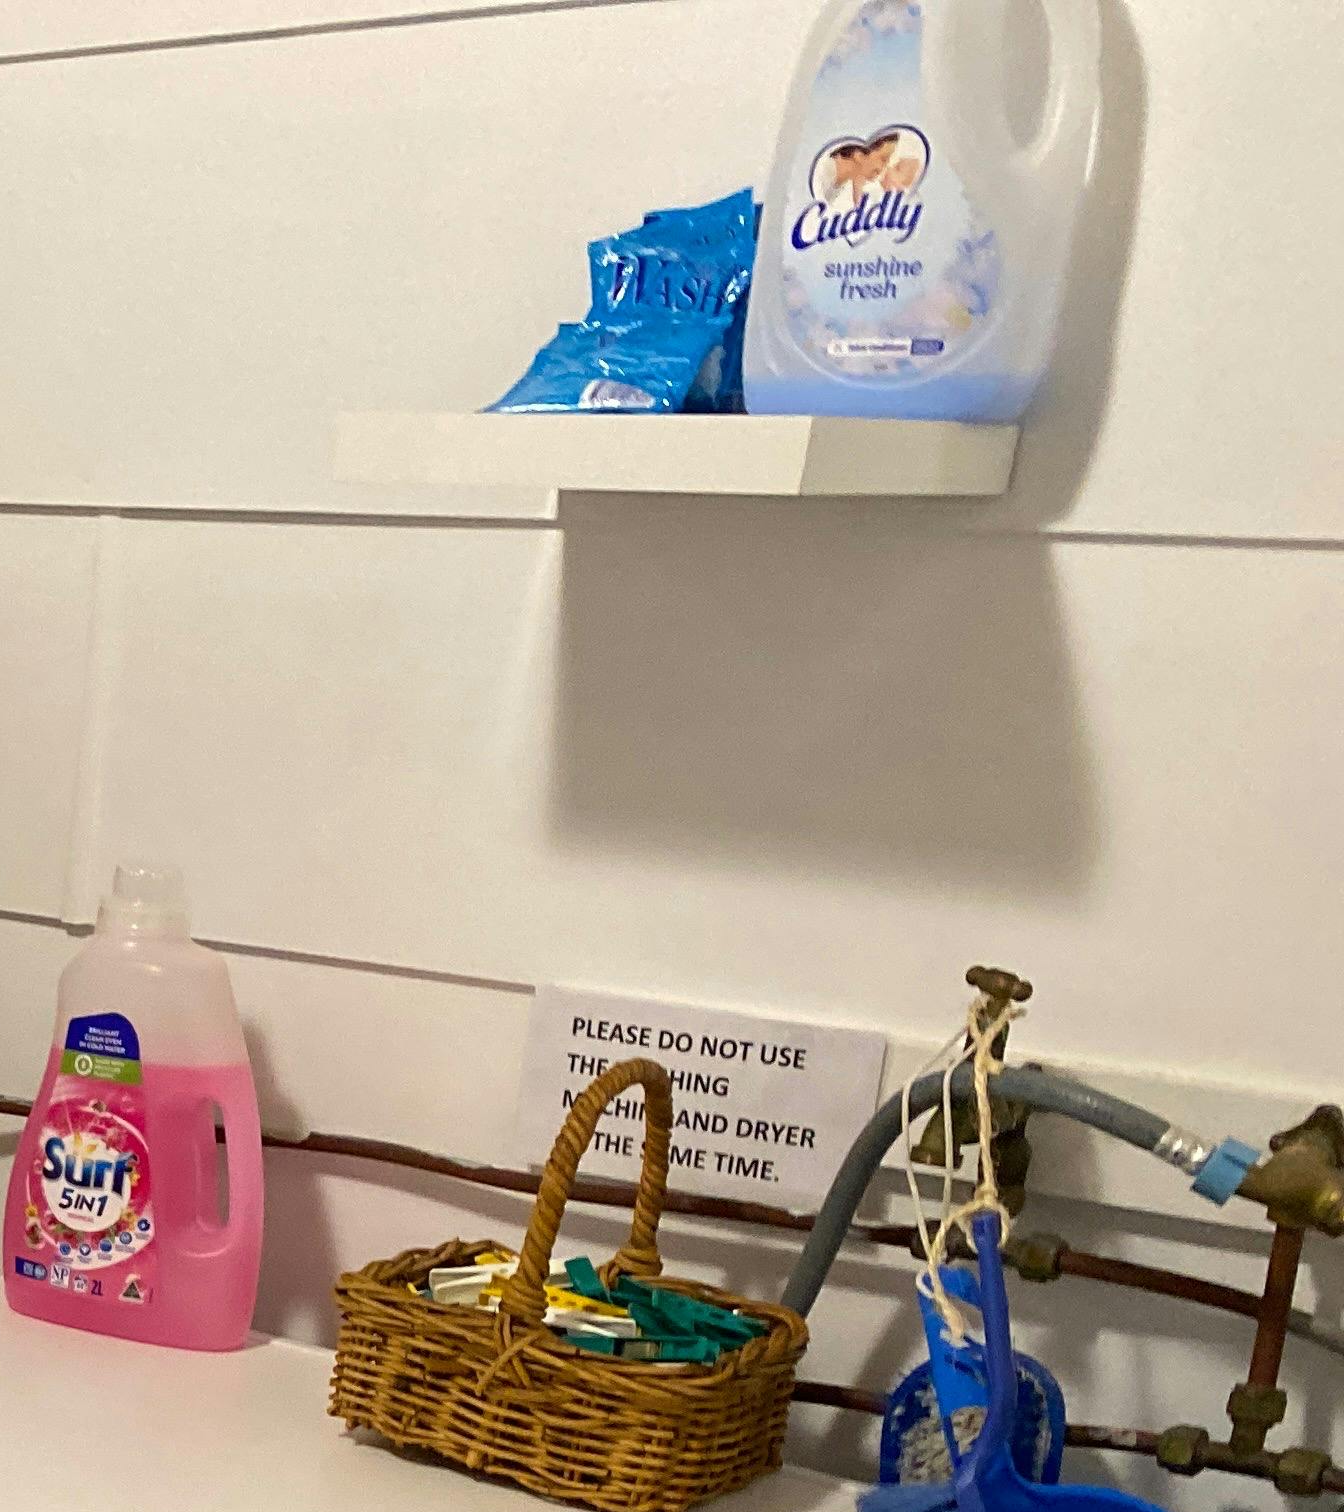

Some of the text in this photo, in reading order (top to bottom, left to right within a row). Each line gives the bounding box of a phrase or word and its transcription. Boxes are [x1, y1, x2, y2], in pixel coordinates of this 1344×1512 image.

[792, 191, 923, 249] Cuddly
[824, 256, 922, 278] sunshine
[840, 279, 896, 299] fresh
[572, 1016, 807, 1070] PLEASE DO NOT USE
[676, 1109, 728, 1134] AND
[736, 1118, 816, 1148] DRYER
[42, 1136, 138, 1196] Surf
[593, 1132, 634, 1156] THE
[714, 1152, 779, 1182] TIME.
